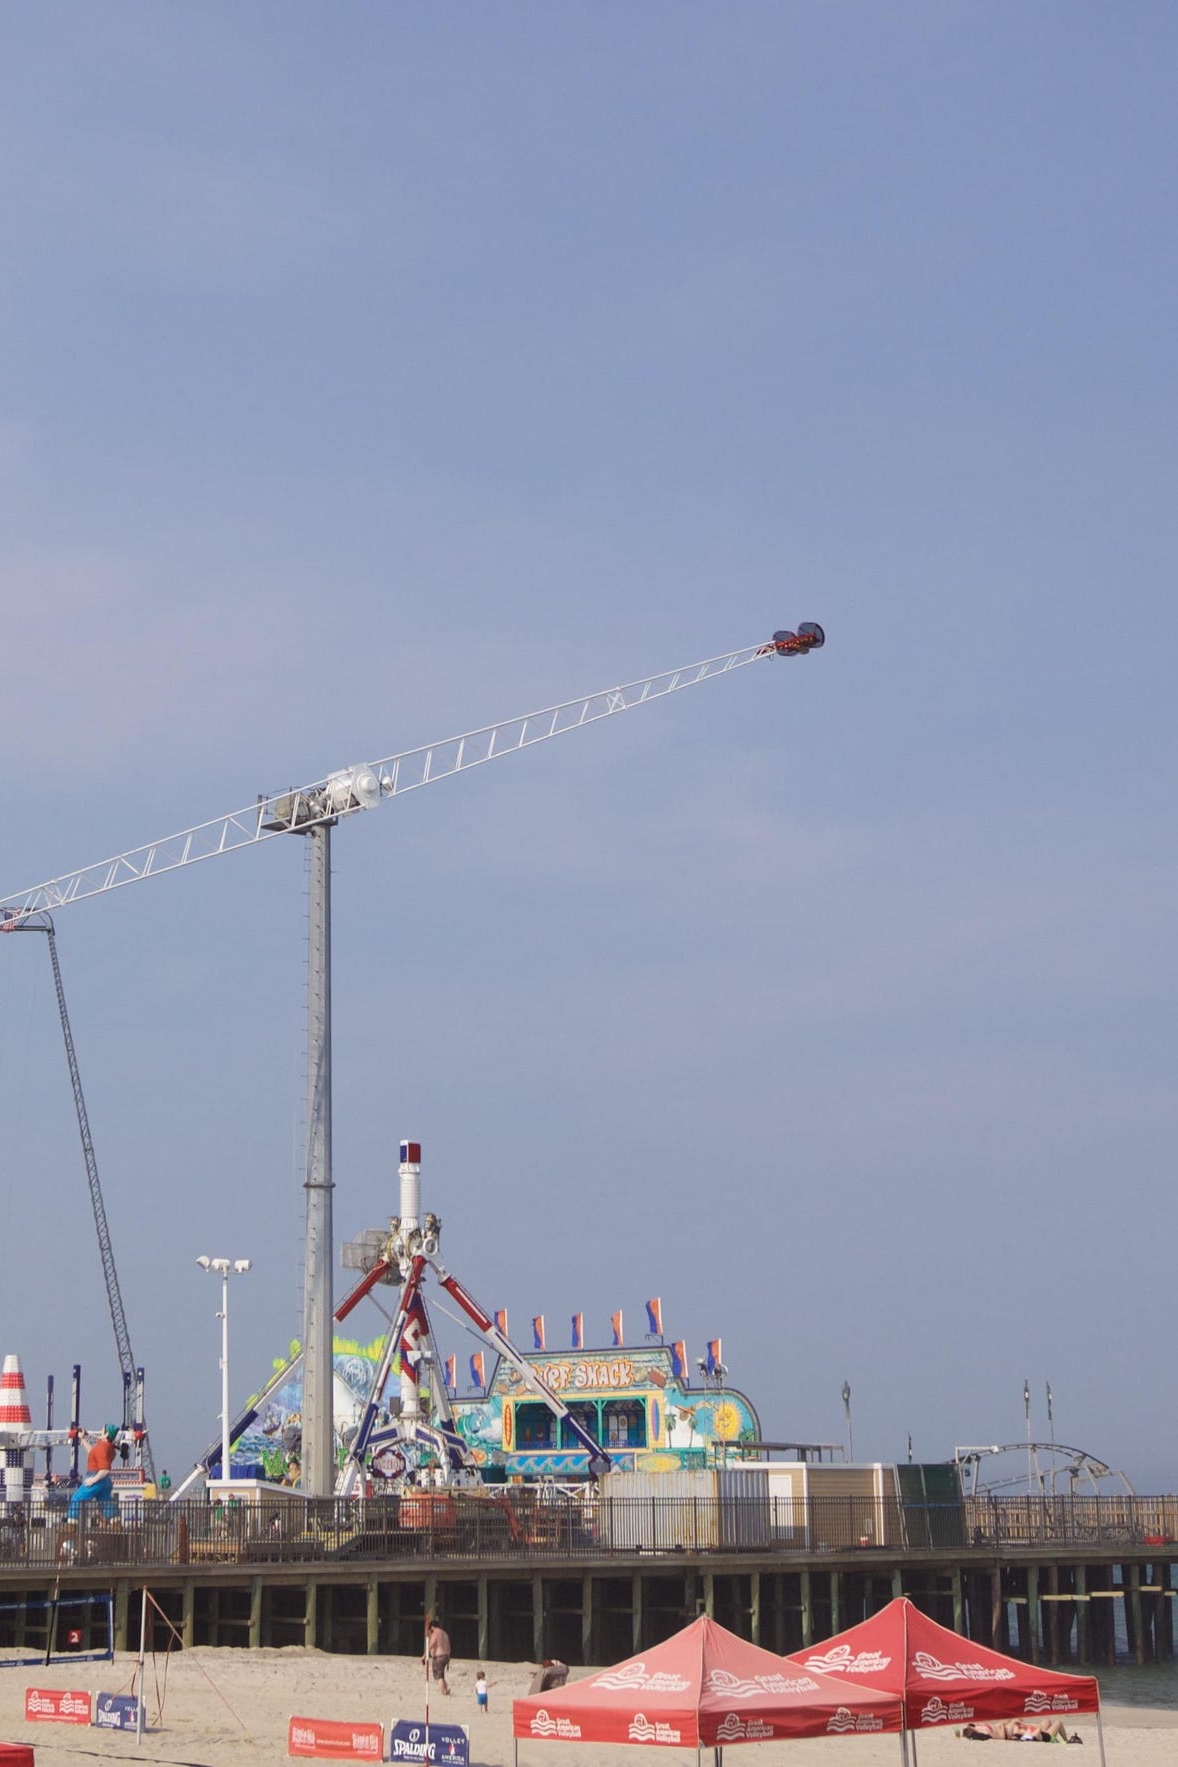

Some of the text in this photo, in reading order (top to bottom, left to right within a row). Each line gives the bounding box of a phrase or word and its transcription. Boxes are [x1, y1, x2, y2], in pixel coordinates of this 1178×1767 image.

[574, 1359, 634, 1388] SHACK
[69, 1631, 80, 1644] 2
[441, 1736, 465, 1744] VOLLEY
